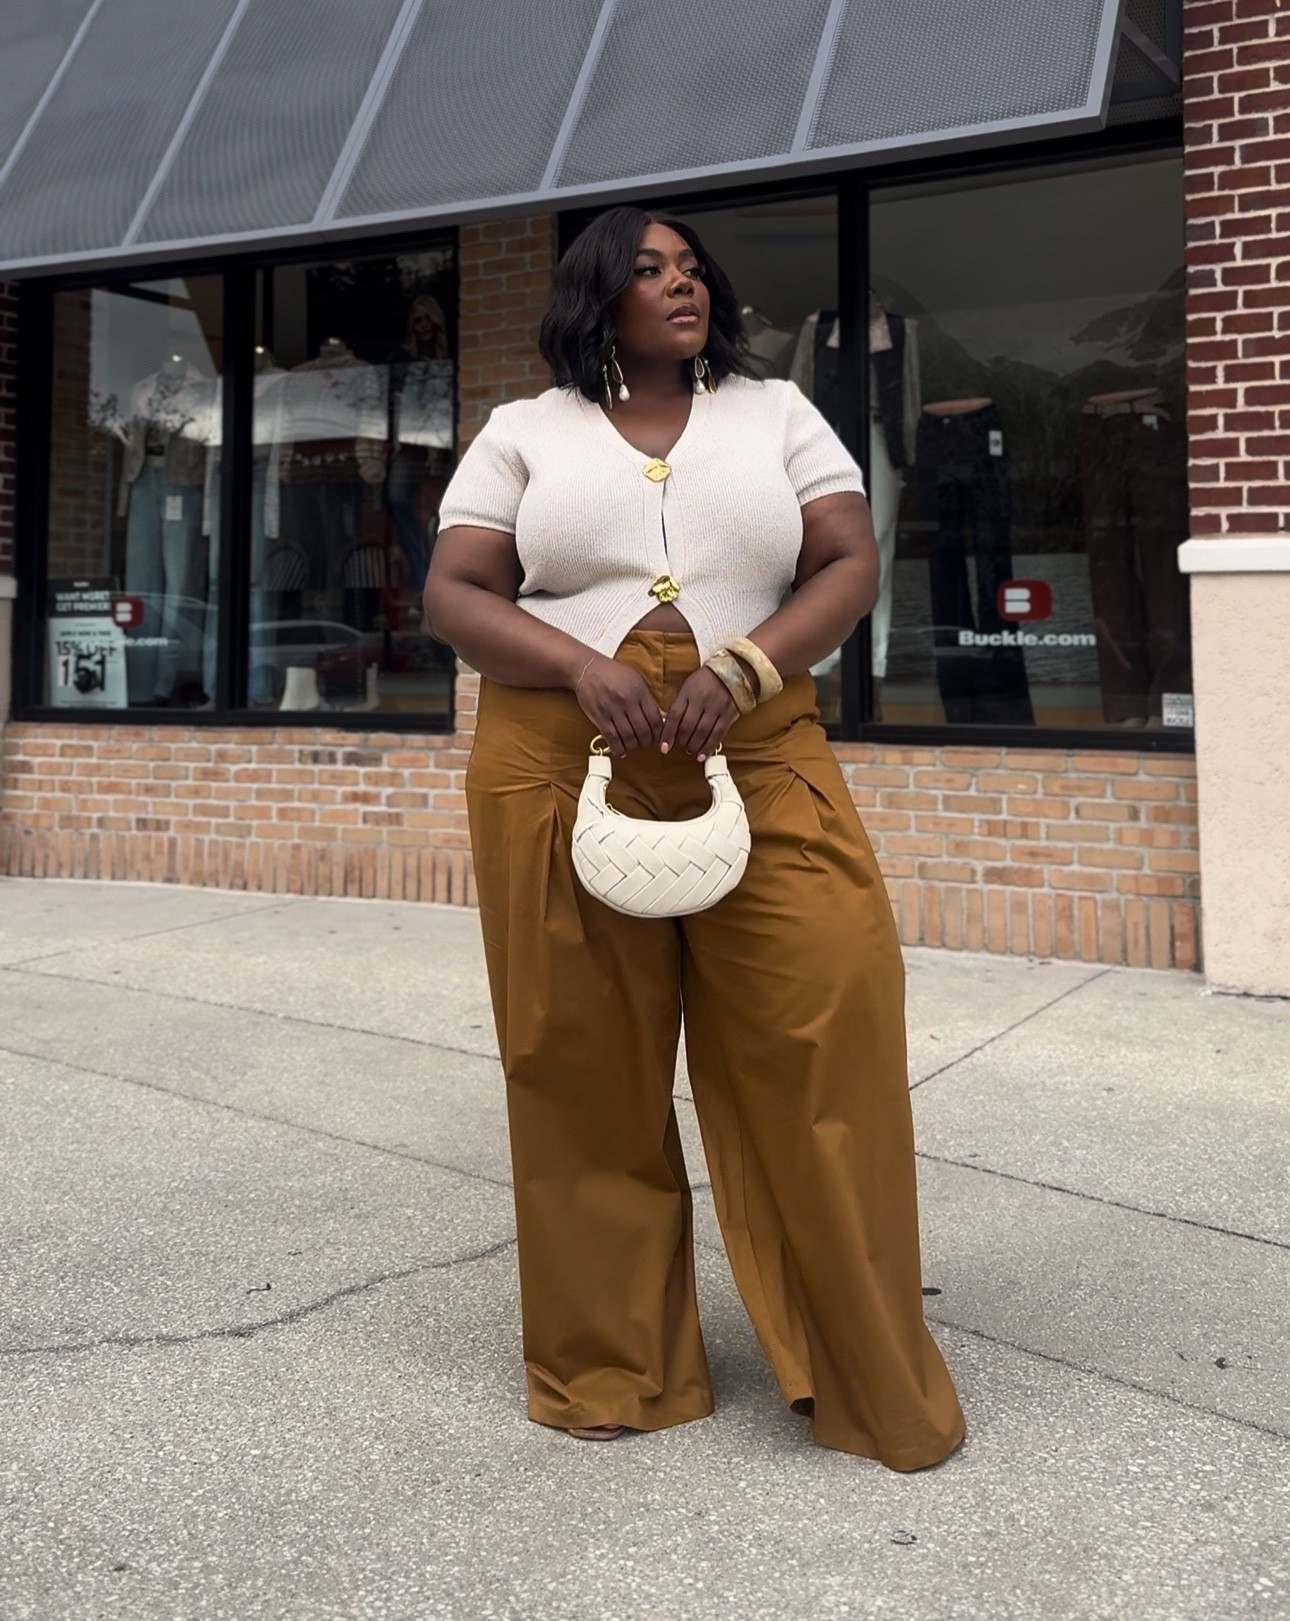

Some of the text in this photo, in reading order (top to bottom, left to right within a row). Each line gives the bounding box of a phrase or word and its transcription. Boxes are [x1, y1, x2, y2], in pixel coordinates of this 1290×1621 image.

[55, 592, 80, 601] WANT
[55, 602, 72, 612] GET
[958, 630, 1096, 646] Buckle.com
